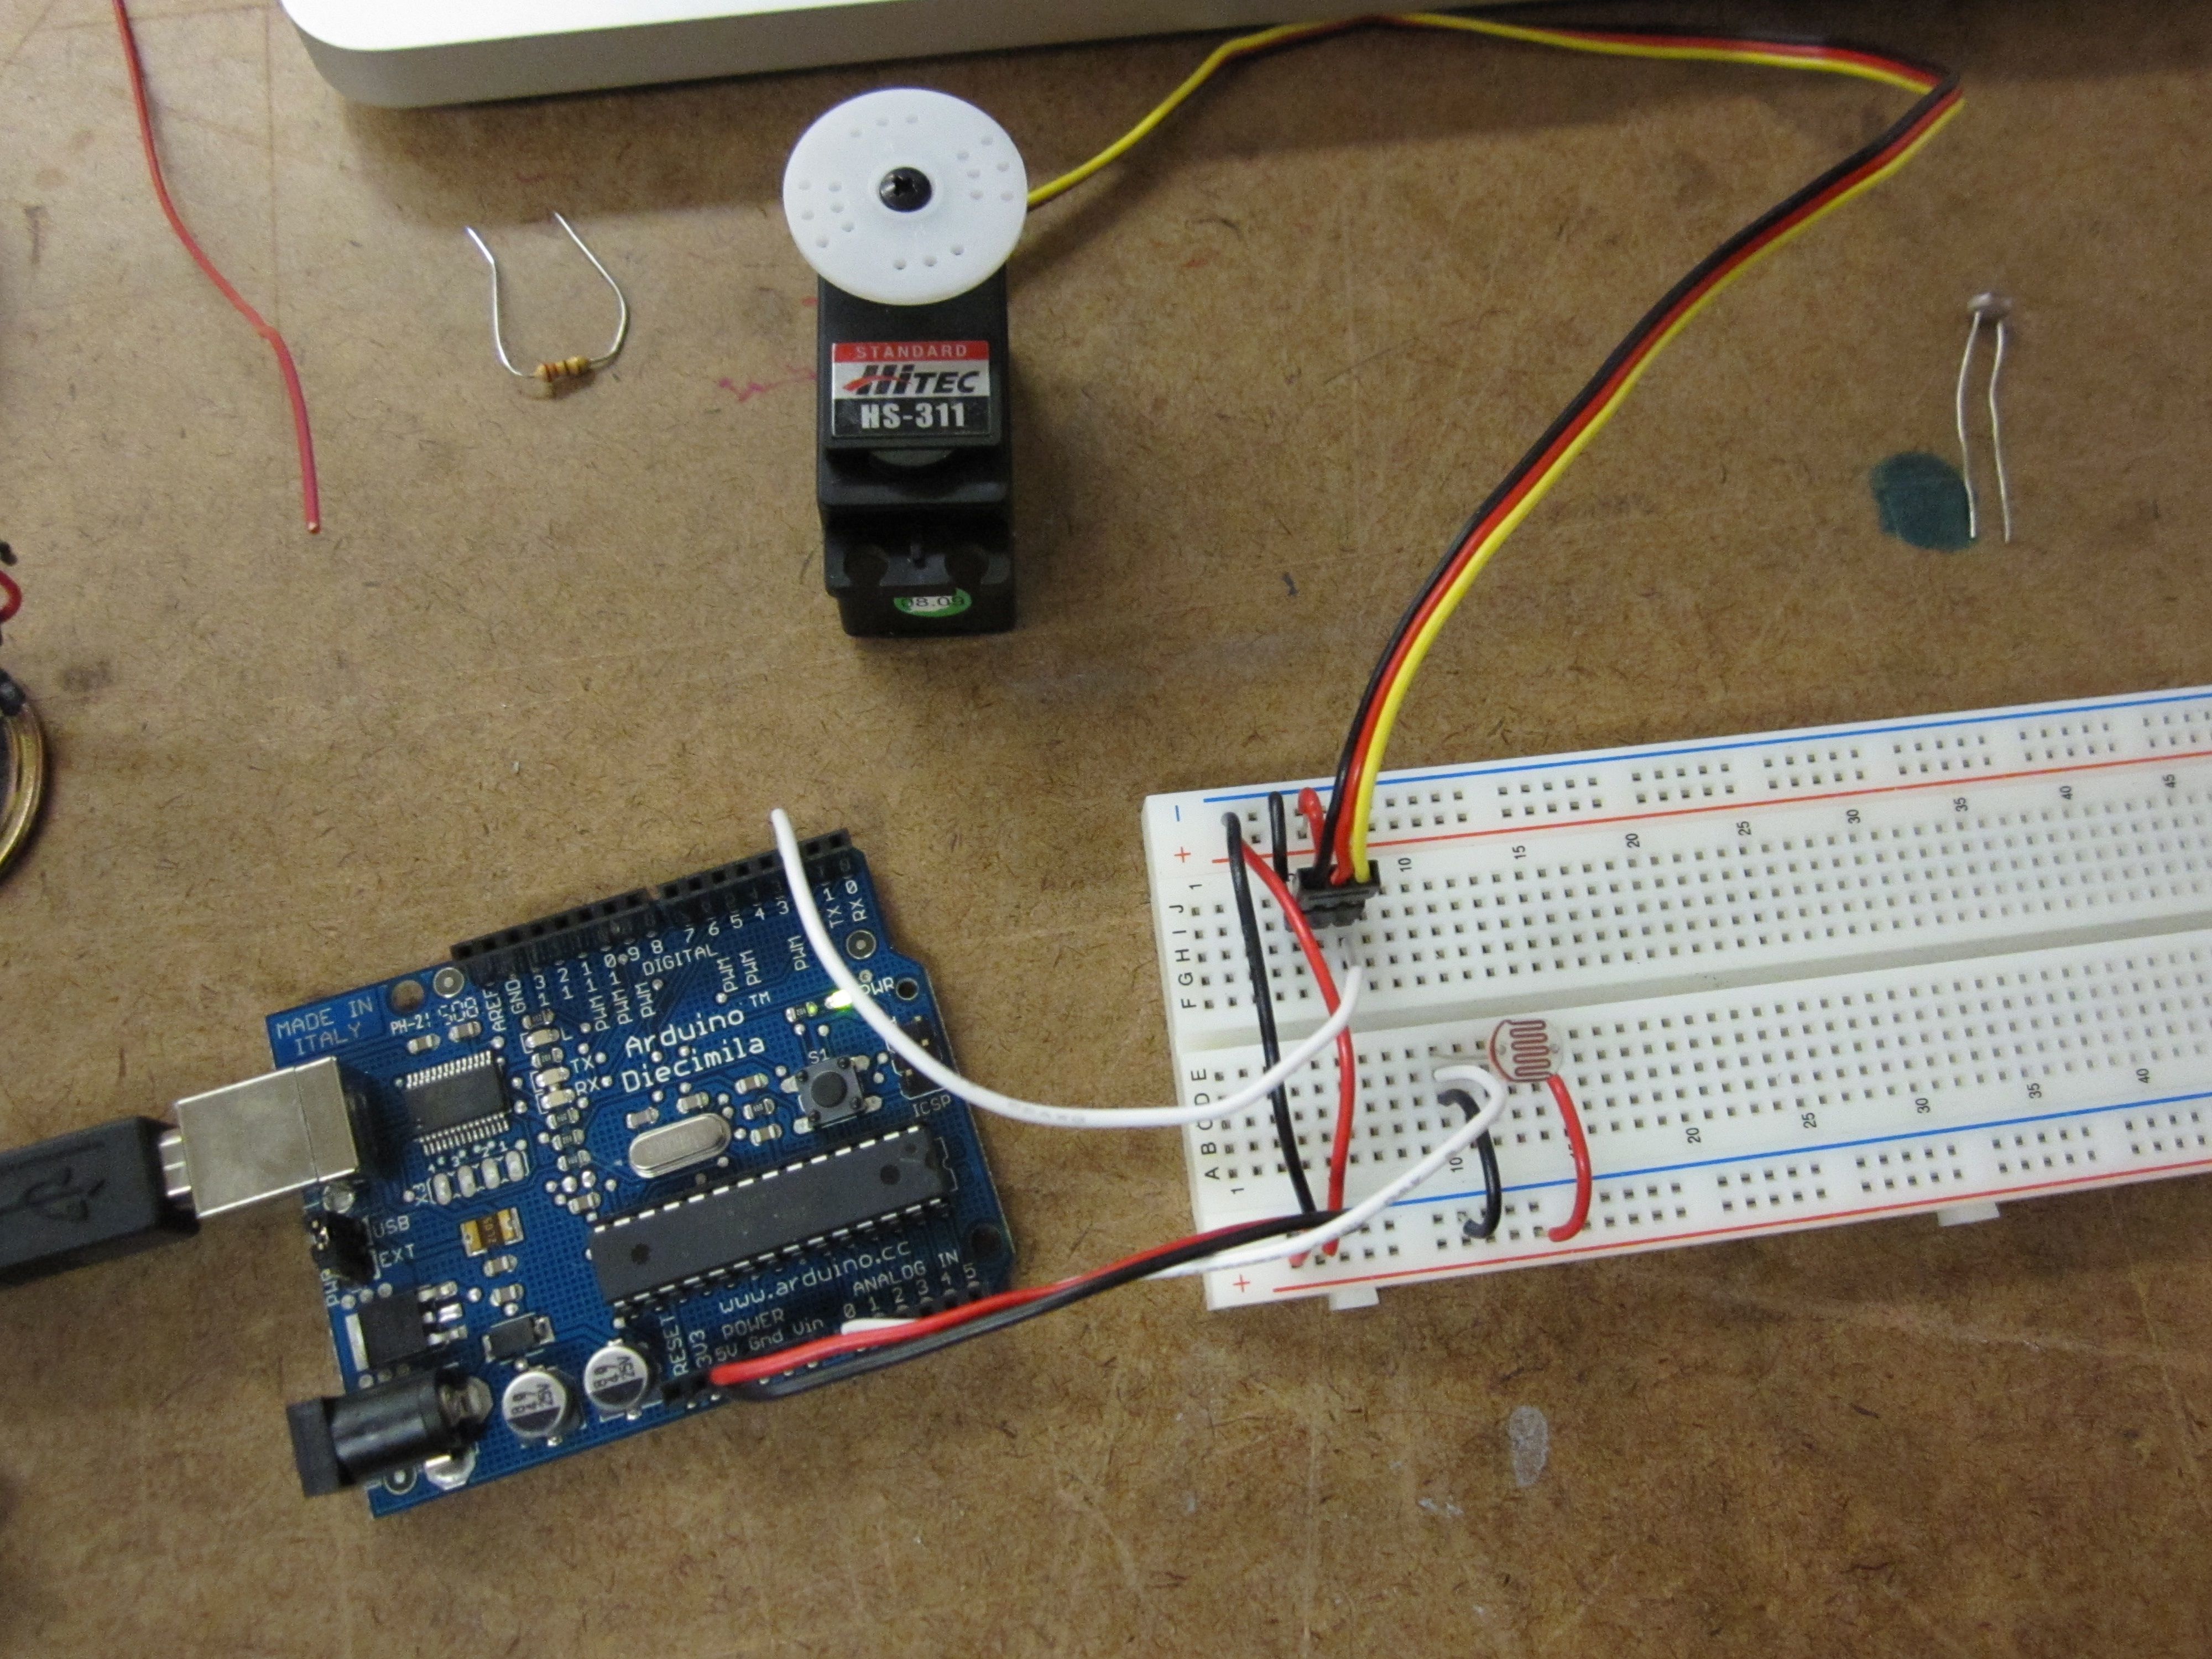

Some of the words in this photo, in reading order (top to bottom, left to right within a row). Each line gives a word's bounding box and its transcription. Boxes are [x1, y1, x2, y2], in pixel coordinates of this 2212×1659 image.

[857, 345, 967, 358] STANDARD
[860, 402, 964, 429] HS-311
[1397, 857, 1412, 872] 10
[1512, 845, 1526, 859] 15
[1625, 833, 1640, 848] 20
[1736, 821, 1751, 836] 25
[1846, 809, 1861, 824] 30
[1953, 797, 1968, 812] 35
[2059, 785, 2073, 800] 40
[2162, 774, 2176, 789] 45
[827, 905, 845, 930] TX
[849, 898, 868, 922] RX
[1168, 904, 1185, 914] J
[642, 943, 719, 977] DIGITAL
[787, 935, 811, 972] PWM
[1175, 948, 1191, 962] H
[717, 957, 739, 994] PWM
[739, 950, 763, 987] PWM
[1178, 972, 1193, 986] G
[504, 978, 527, 1015] GND
[611, 989, 634, 1025] PWM
[635, 982, 657, 1019] PWM
[748, 990, 772, 1008] TM
[1181, 998, 1197, 1009] F
[276, 1008, 335, 1041] MADE
[348, 996, 374, 1019] IN
[482, 989, 507, 1032] AREF
[589, 995, 611, 1032] PWM
[294, 1022, 361, 1056] ITALY
[560, 1027, 574, 1041] L
[625, 1009, 745, 1058] Arduino
[570, 1055, 596, 1073] TX
[621, 1037, 766, 1093] Diecimila
[808, 1048, 830, 1065] S1
[575, 1076, 601, 1097] RX
[1191, 1068, 1207, 1082] E
[912, 1094, 951, 1118] ICSP
[1194, 1093, 1210, 1106] D
[1449, 1156, 1464, 1173] 10
[1687, 1126, 1702, 1144] 20
[1803, 1112, 1817, 1129] 25
[1917, 1097, 1931, 1114] 30
[2026, 1082, 2042, 1099] 35
[2136, 1068, 2150, 1084] 40
[1201, 1141, 1217, 1155] B
[1204, 1166, 1220, 1180] A
[372, 1214, 410, 1239] USB
[379, 1243, 414, 1269] EXT
[719, 1241, 911, 1315] www.arduino.cc
[852, 1260, 927, 1297] ANALOG
[937, 1249, 959, 1268] IN
[915, 1279, 929, 1295] 3
[962, 1262, 977, 1279] 5
[721, 1307, 785, 1340] POWER
[659, 1316, 689, 1377] RESET
[748, 1329, 784, 1352] Gnd
